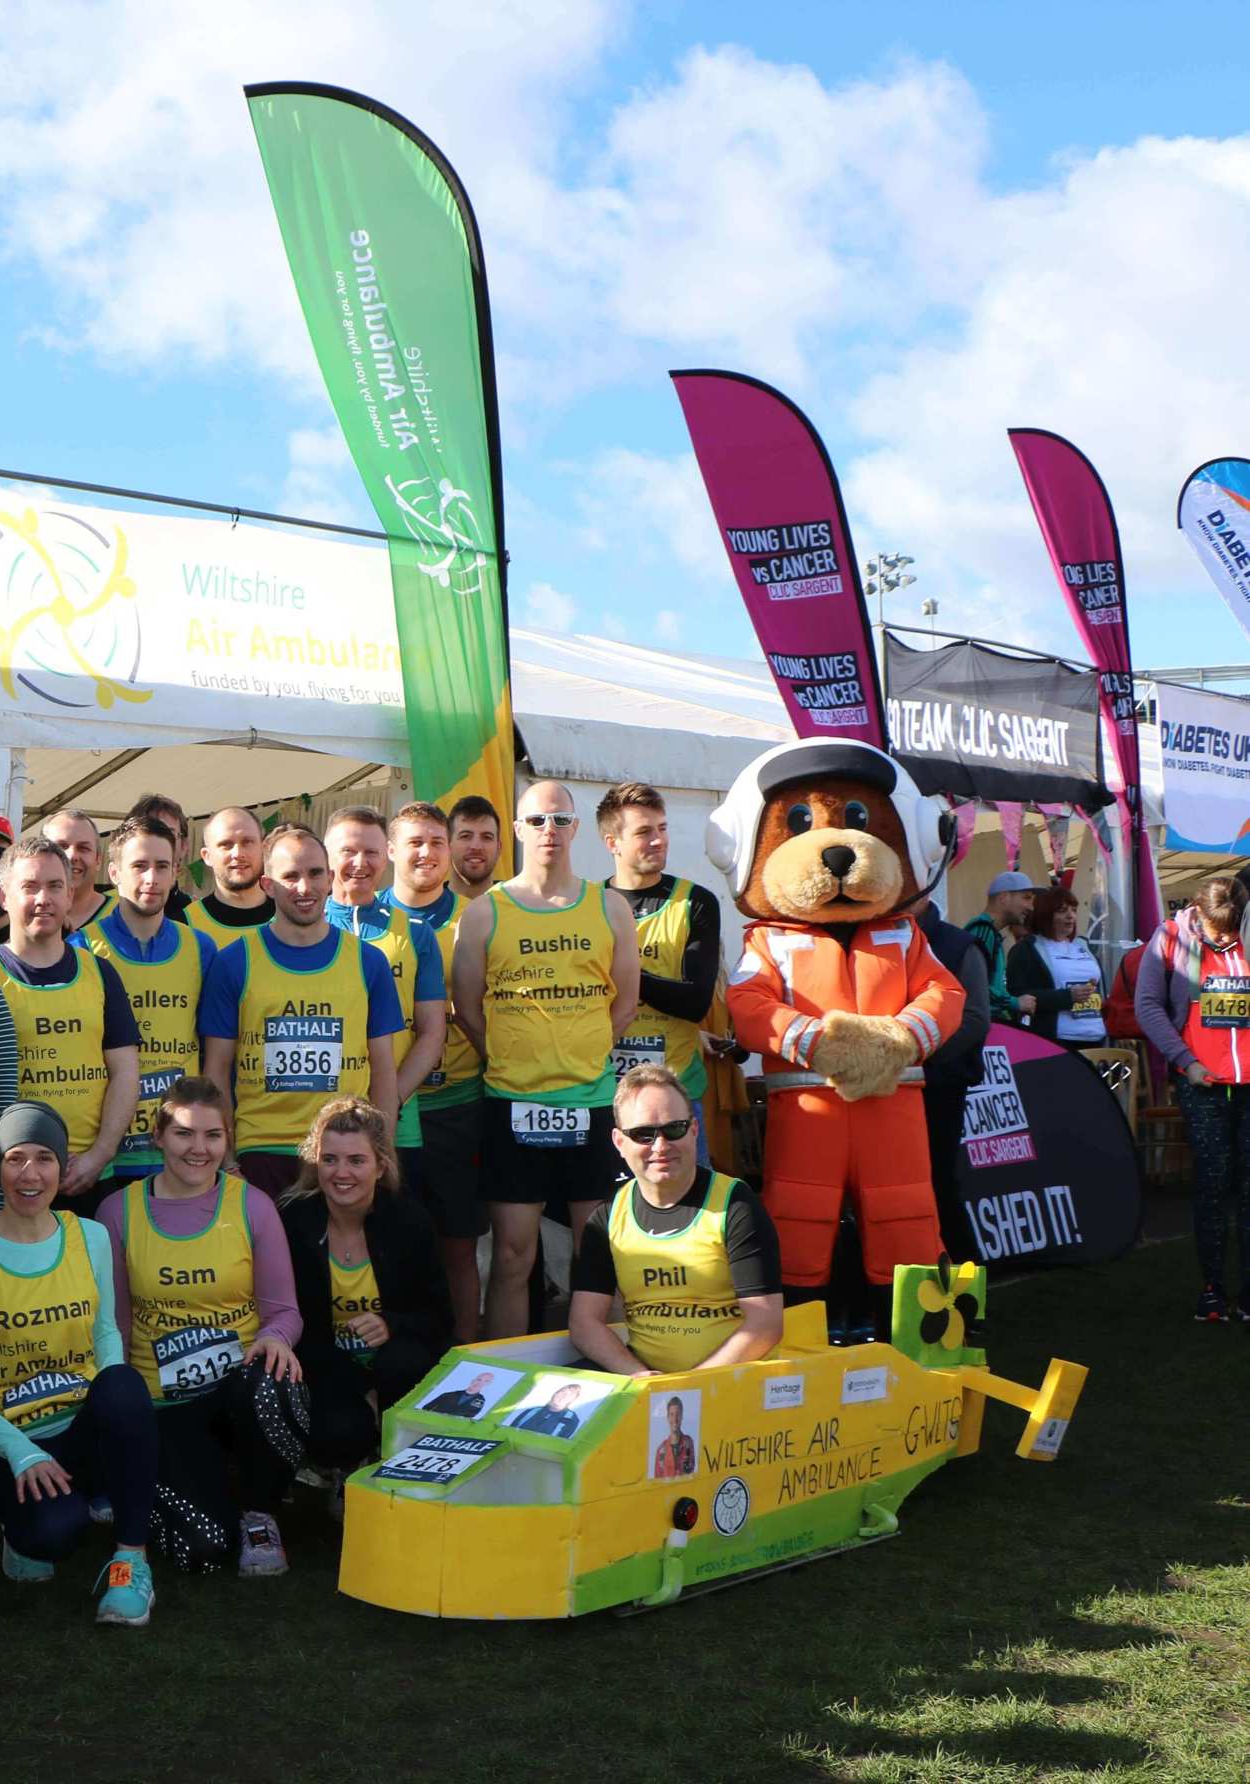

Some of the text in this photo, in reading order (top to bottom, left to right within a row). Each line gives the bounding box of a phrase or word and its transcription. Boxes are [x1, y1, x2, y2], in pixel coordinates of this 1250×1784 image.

[727, 523, 831, 553] YOUNG LIVES
[752, 550, 838, 584] vs CANCER
[181, 563, 305, 610] Wiltshire
[793, 577, 841, 597] SARGENT
[185, 616, 239, 656] Air
[770, 654, 855, 680] YOUNG LIVES
[191, 670, 249, 691] funded
[252, 676, 270, 697] by
[308, 682, 350, 702] flying
[350, 686, 370, 701] for
[374, 690, 400, 706] you
[807, 680, 863, 707] CANCER
[901, 701, 1069, 766] TEAM CLIC SARGENT
[520, 935, 591, 955] Bushie
[281, 1000, 332, 1016] Alan
[36, 1017, 82, 1035] Ben
[268, 1021, 341, 1038] BATHALF
[616, 1034, 664, 1047] HALF
[275, 1050, 332, 1075] 3856
[524, 1108, 579, 1131] 1855
[965, 1091, 1025, 1136] CANCER
[967, 1135, 1034, 1166] CLIC SARGENT
[1044, 1185, 1083, 1246] IT!
[159, 1267, 216, 1286] Sam
[643, 1266, 686, 1287] Phil
[156, 1301, 255, 1328] Ambulance
[330, 1296, 384, 1313] Kate
[668, 1325, 701, 1336] for you
[176, 1352, 236, 1388] 5312
[416, 1437, 497, 1452] BATHALF
[704, 1417, 841, 1474] WILTSHIRE AIR
[395, 1455, 461, 1472] 2478
[778, 1446, 883, 1504] AMBULANCE
